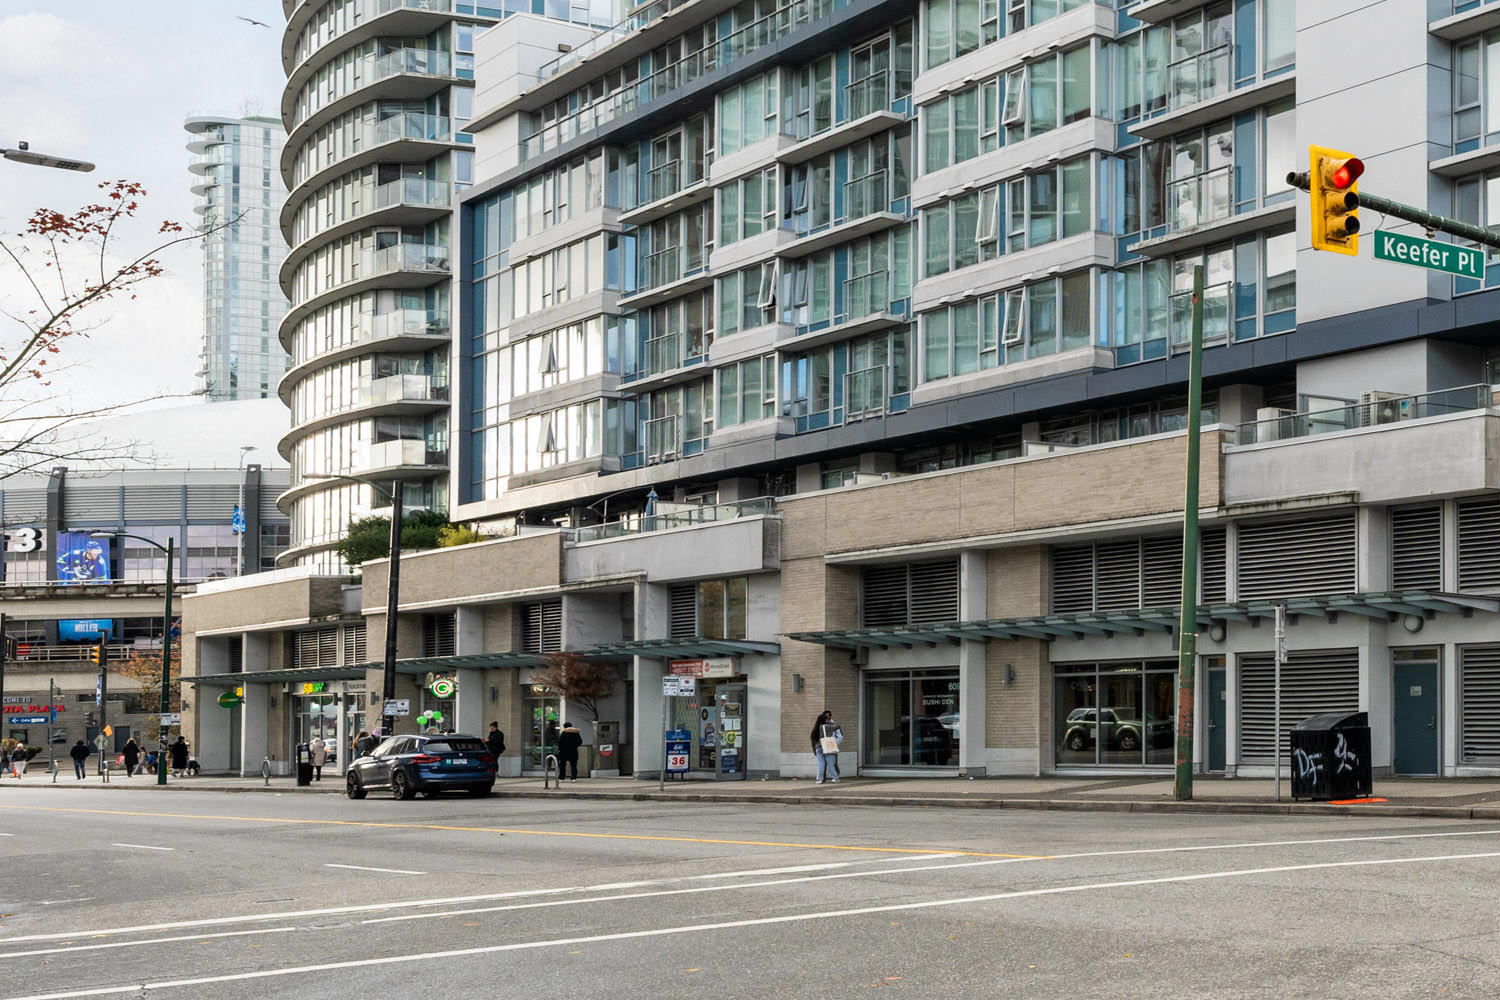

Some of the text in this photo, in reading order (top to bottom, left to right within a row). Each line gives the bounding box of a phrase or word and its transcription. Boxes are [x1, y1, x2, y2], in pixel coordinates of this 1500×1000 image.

[1384, 236, 1475, 273] Keefer Pl
[14, 527, 38, 553] 3
[27, 704, 65, 713] PLAA
[672, 756, 685, 765] 36
